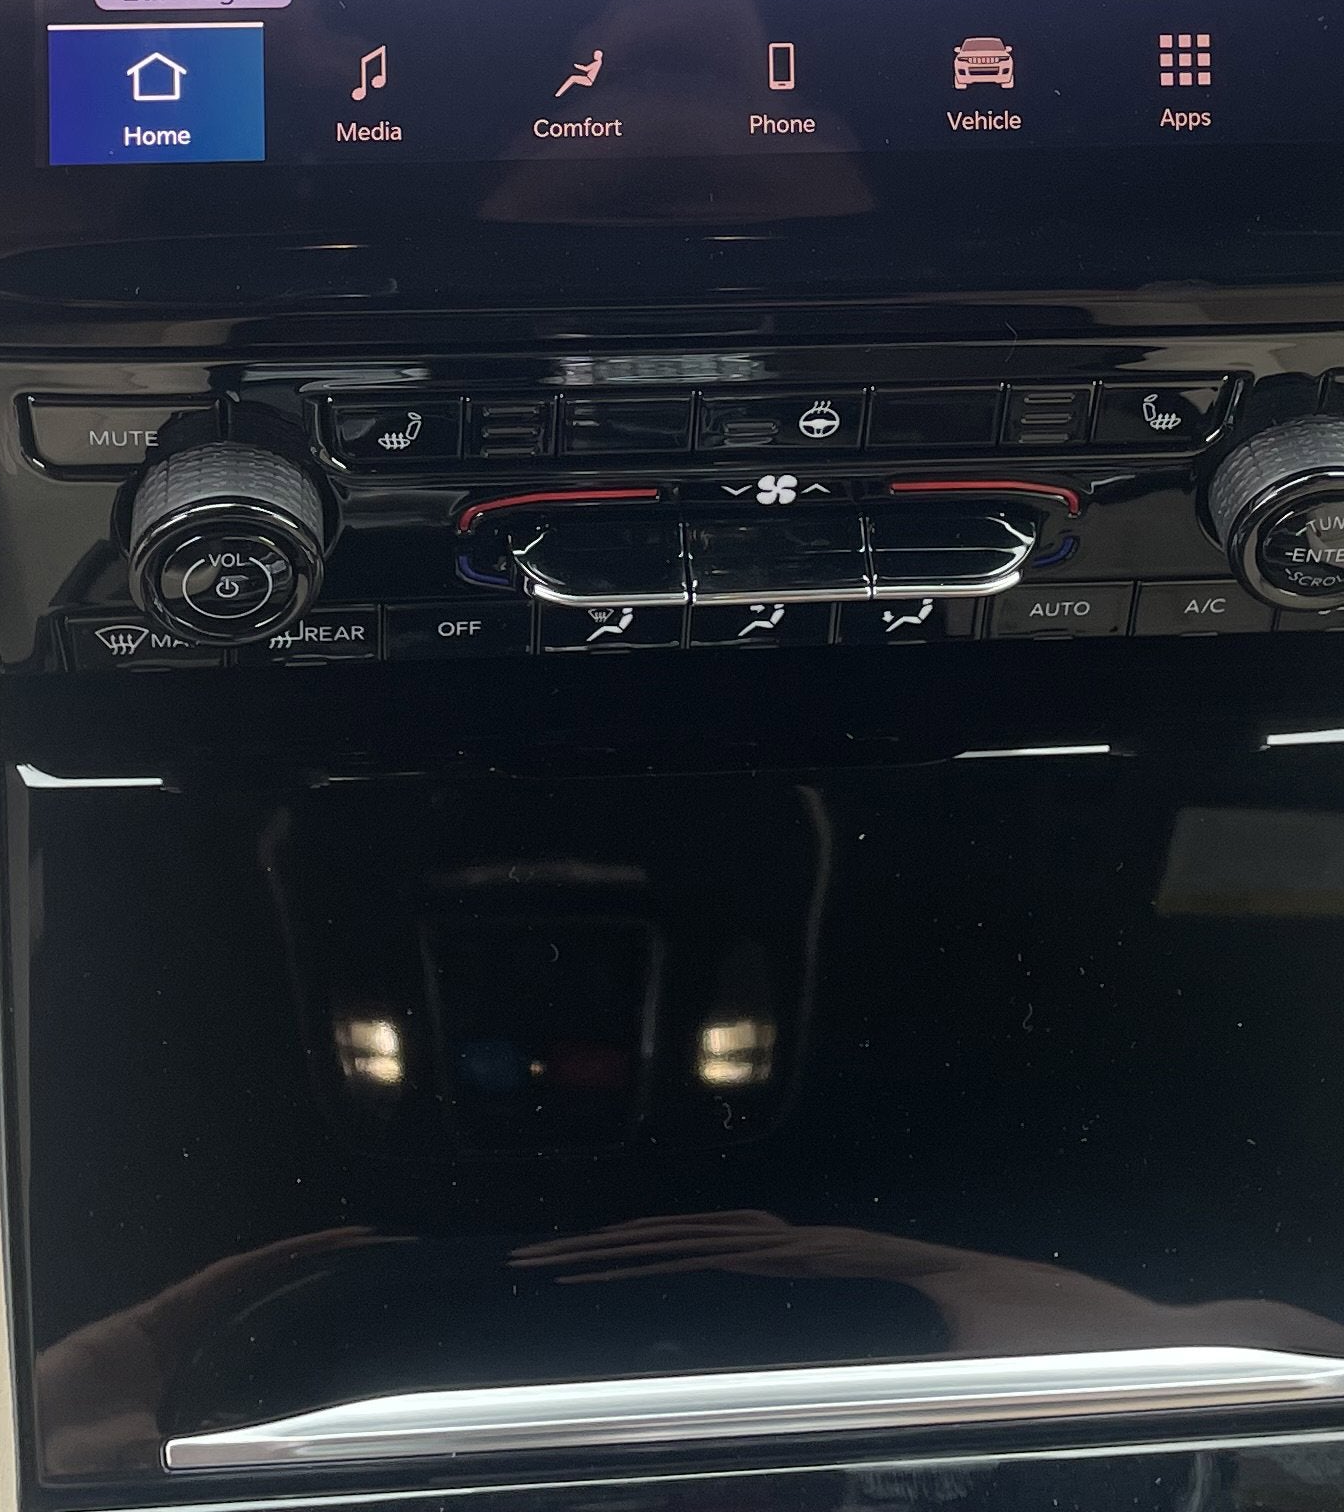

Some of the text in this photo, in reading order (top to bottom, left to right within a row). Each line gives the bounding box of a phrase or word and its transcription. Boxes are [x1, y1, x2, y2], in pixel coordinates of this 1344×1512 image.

[533, 117, 623, 138] Comfort
[750, 114, 816, 134] Phone
[946, 110, 1022, 131] Vehicle
[1159, 108, 1212, 131] Apps
[124, 126, 191, 147] Home
[336, 120, 402, 142] Media
[88, 429, 160, 448] MUTE
[208, 553, 246, 568] VOL
[1029, 601, 1090, 617] AUTO
[1183, 597, 1227, 615] A/C
[304, 624, 366, 642] REAR
[437, 620, 482, 637] OFF
[150, 632, 201, 648] MA
